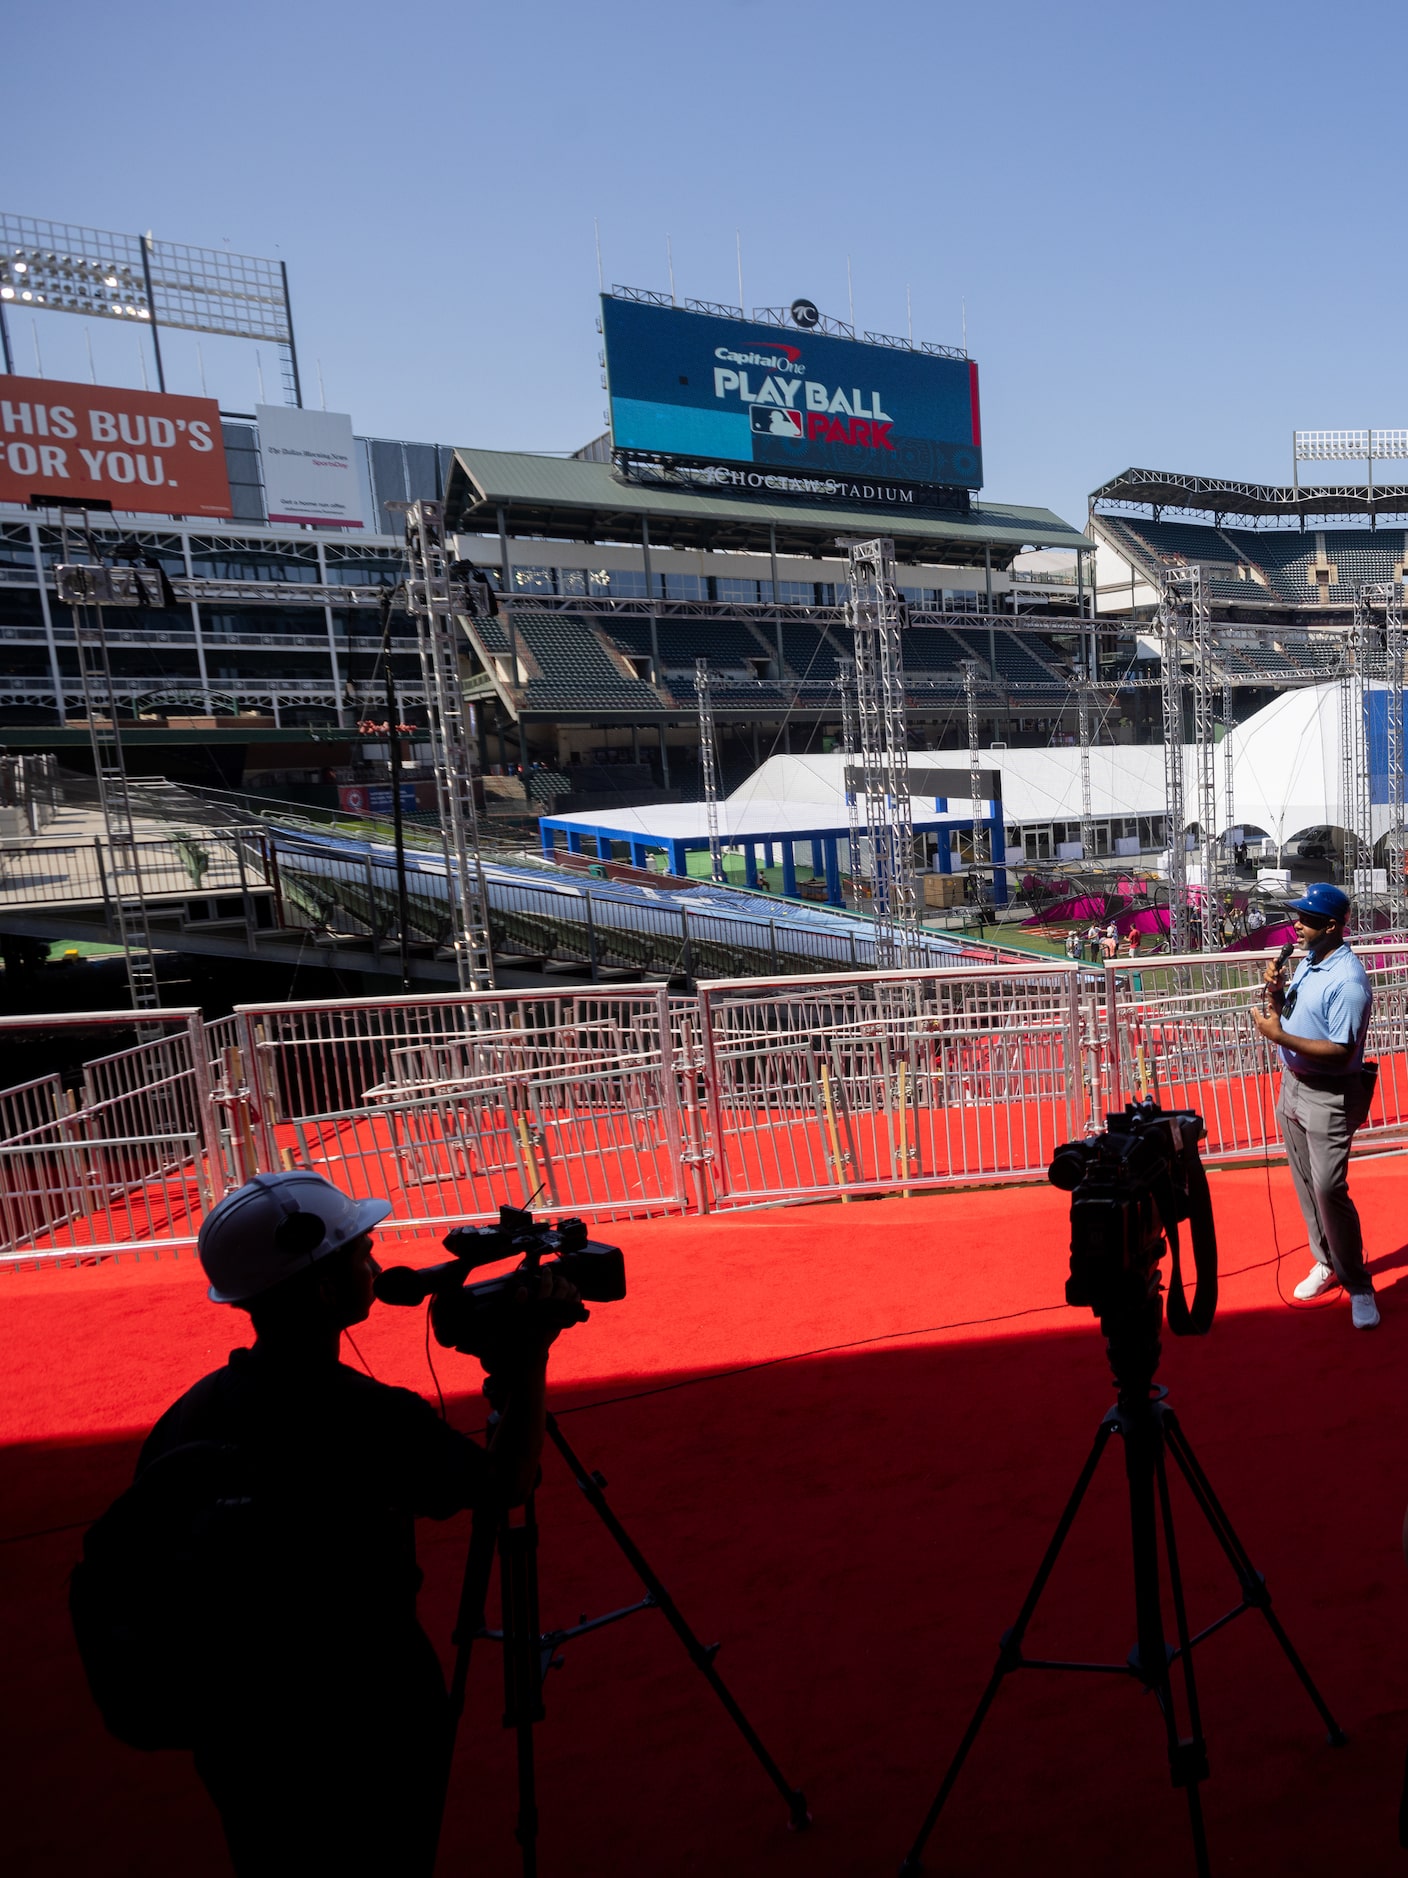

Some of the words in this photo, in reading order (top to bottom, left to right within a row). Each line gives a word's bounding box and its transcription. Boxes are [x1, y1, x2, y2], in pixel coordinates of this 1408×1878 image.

[88, 409, 214, 453] BUD'S
[806, 411, 895, 450] PARK
[77, 447, 178, 487] YOU.
[714, 467, 819, 493] CHOCTAW
[825, 479, 914, 503] STADIUM
